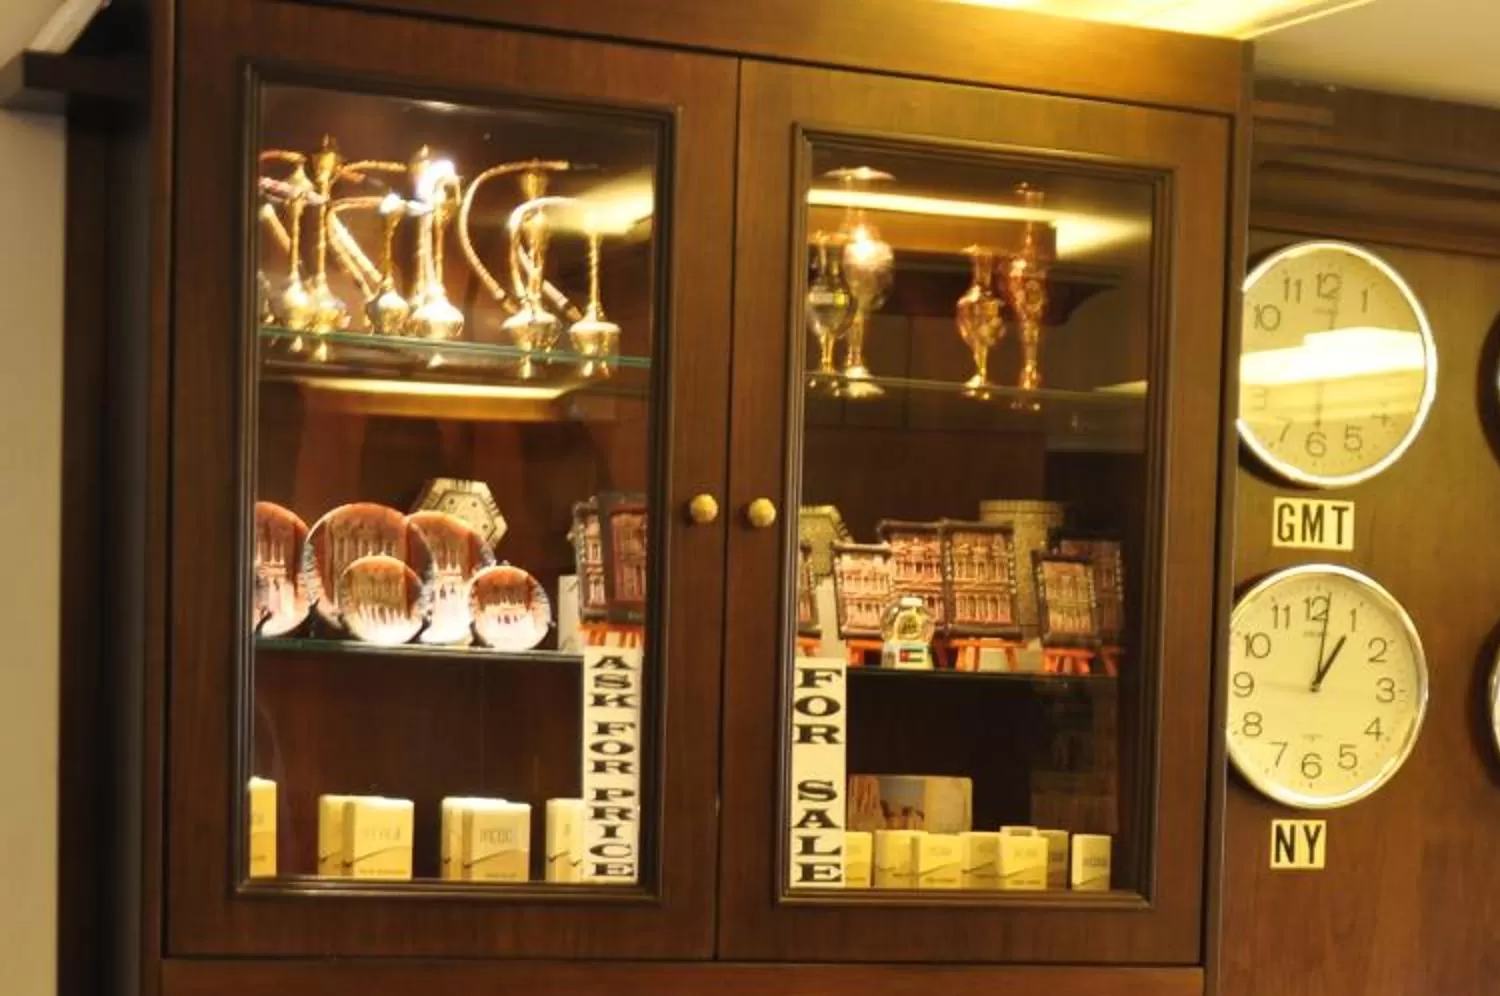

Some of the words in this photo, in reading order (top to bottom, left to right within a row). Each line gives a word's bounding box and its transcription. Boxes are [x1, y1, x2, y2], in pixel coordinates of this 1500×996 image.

[1283, 276, 1301, 304] 11
[1316, 272, 1342, 299] 12
[1361, 288, 1369, 313] 1
[1254, 304, 1280, 331] 10
[1304, 431, 1327, 457] 6
[1344, 424, 1363, 452] 5
[1277, 503, 1349, 546] GMT
[1271, 604, 1290, 630] 11
[1304, 596, 1329, 622] 12
[1350, 608, 1357, 633] 1
[1244, 632, 1271, 659] 10
[1368, 637, 1388, 663] 2
[589, 656, 637, 708] ASK
[1233, 671, 1254, 698] 9
[1376, 677, 1395, 703] 3
[795, 668, 843, 744] FOR
[1242, 712, 1263, 737] 8
[1364, 718, 1383, 741] 4
[589, 721, 638, 774] FOR
[1269, 741, 1288, 768] 7
[1338, 744, 1358, 770] 5
[1301, 753, 1322, 779] 6
[589, 788, 638, 876] PRICE
[793, 780, 843, 882] SALE
[1275, 824, 1322, 864] NY
